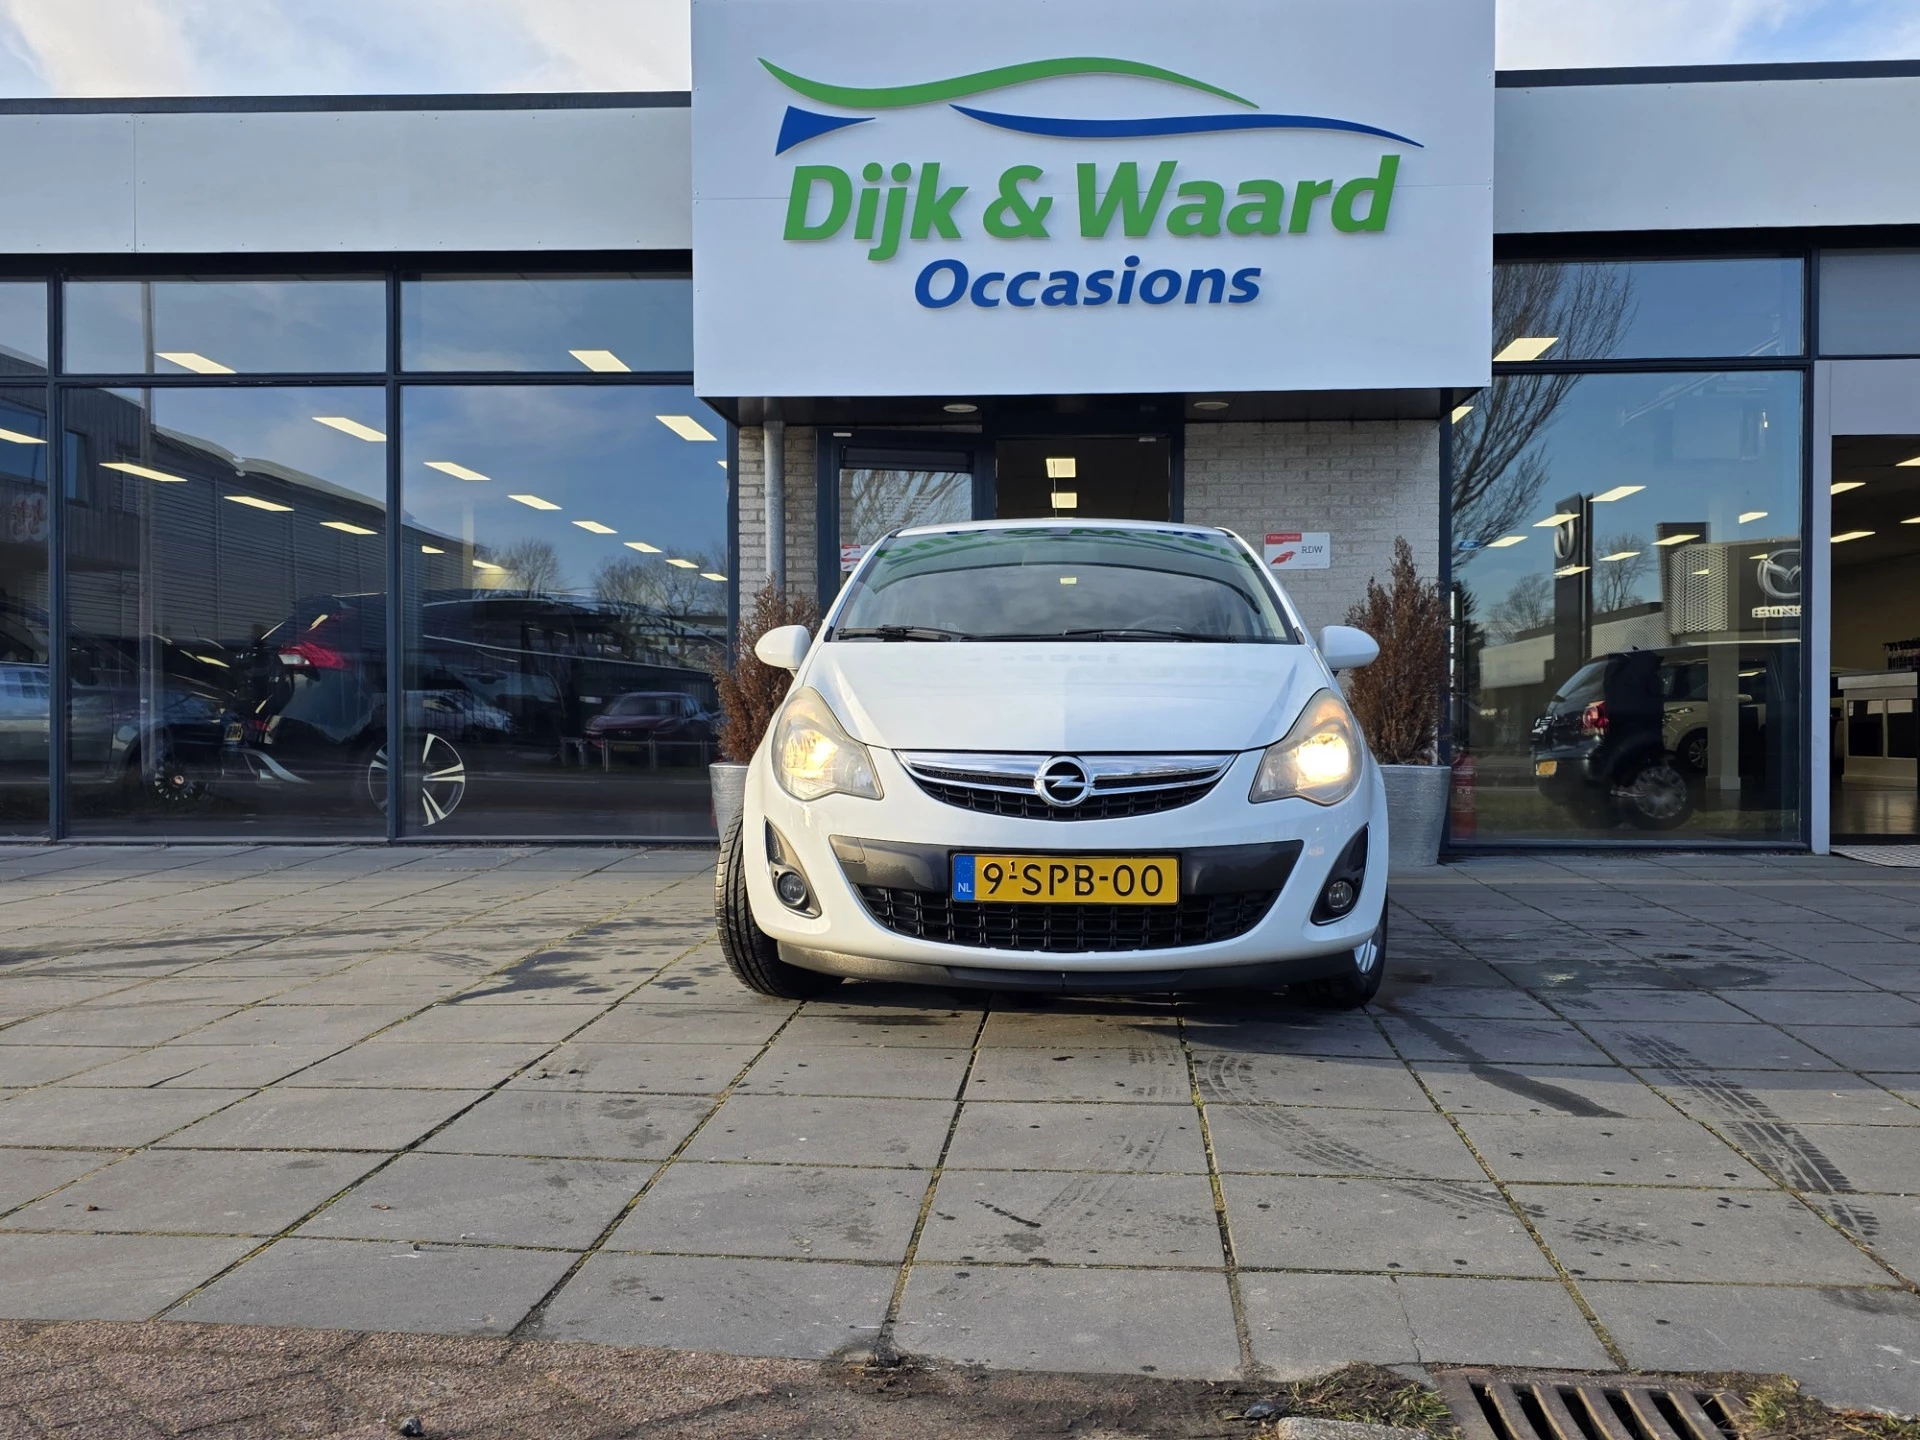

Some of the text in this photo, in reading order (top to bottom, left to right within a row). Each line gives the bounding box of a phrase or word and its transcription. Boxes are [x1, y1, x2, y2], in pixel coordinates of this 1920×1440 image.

[783, 154, 1401, 261] Dijk & Waard
[914, 255, 1262, 309] Occasions
[1301, 545, 1323, 554] RDW
[957, 883, 972, 893] NL
